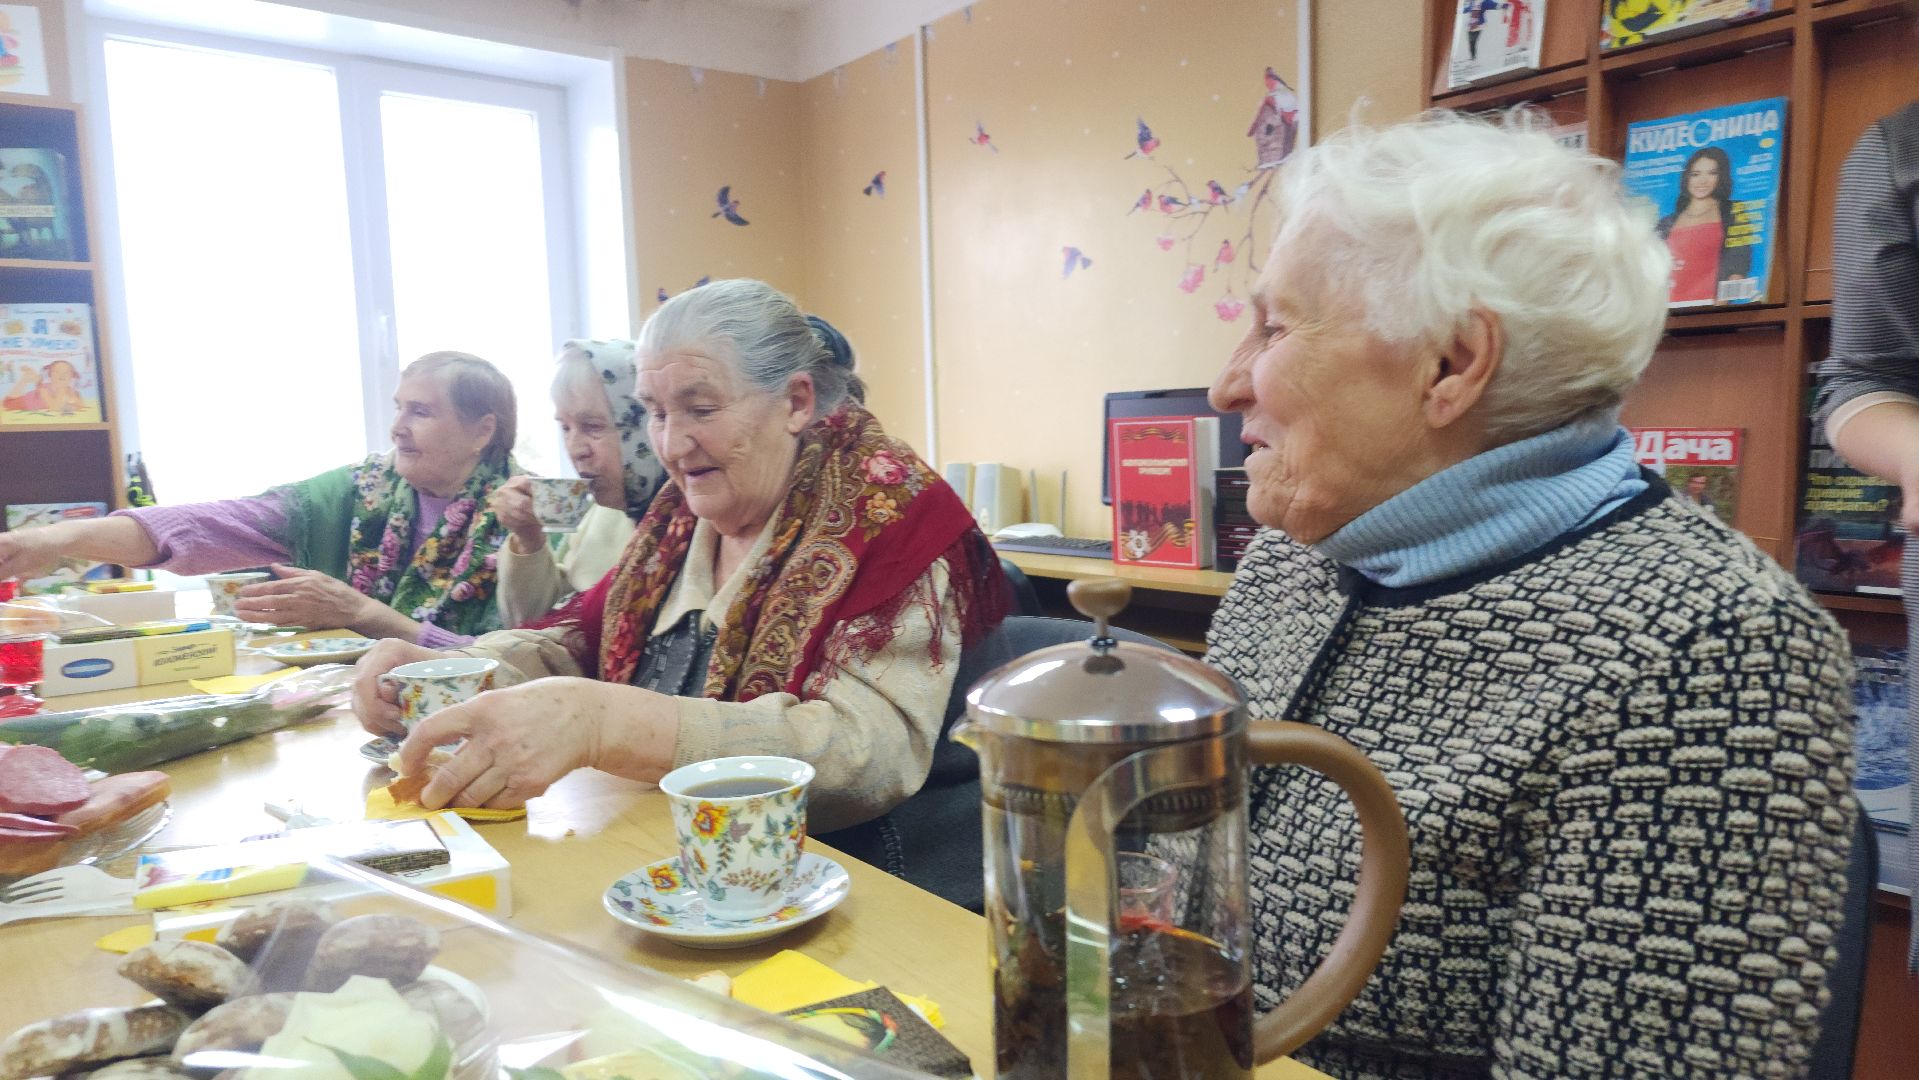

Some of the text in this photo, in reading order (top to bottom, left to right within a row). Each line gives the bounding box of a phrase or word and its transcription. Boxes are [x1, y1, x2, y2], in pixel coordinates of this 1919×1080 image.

[1630, 110, 1779, 153] КУДЕСНИЦА
[32, 318, 49, 335] Я
[1634, 431, 1733, 476] Дача
